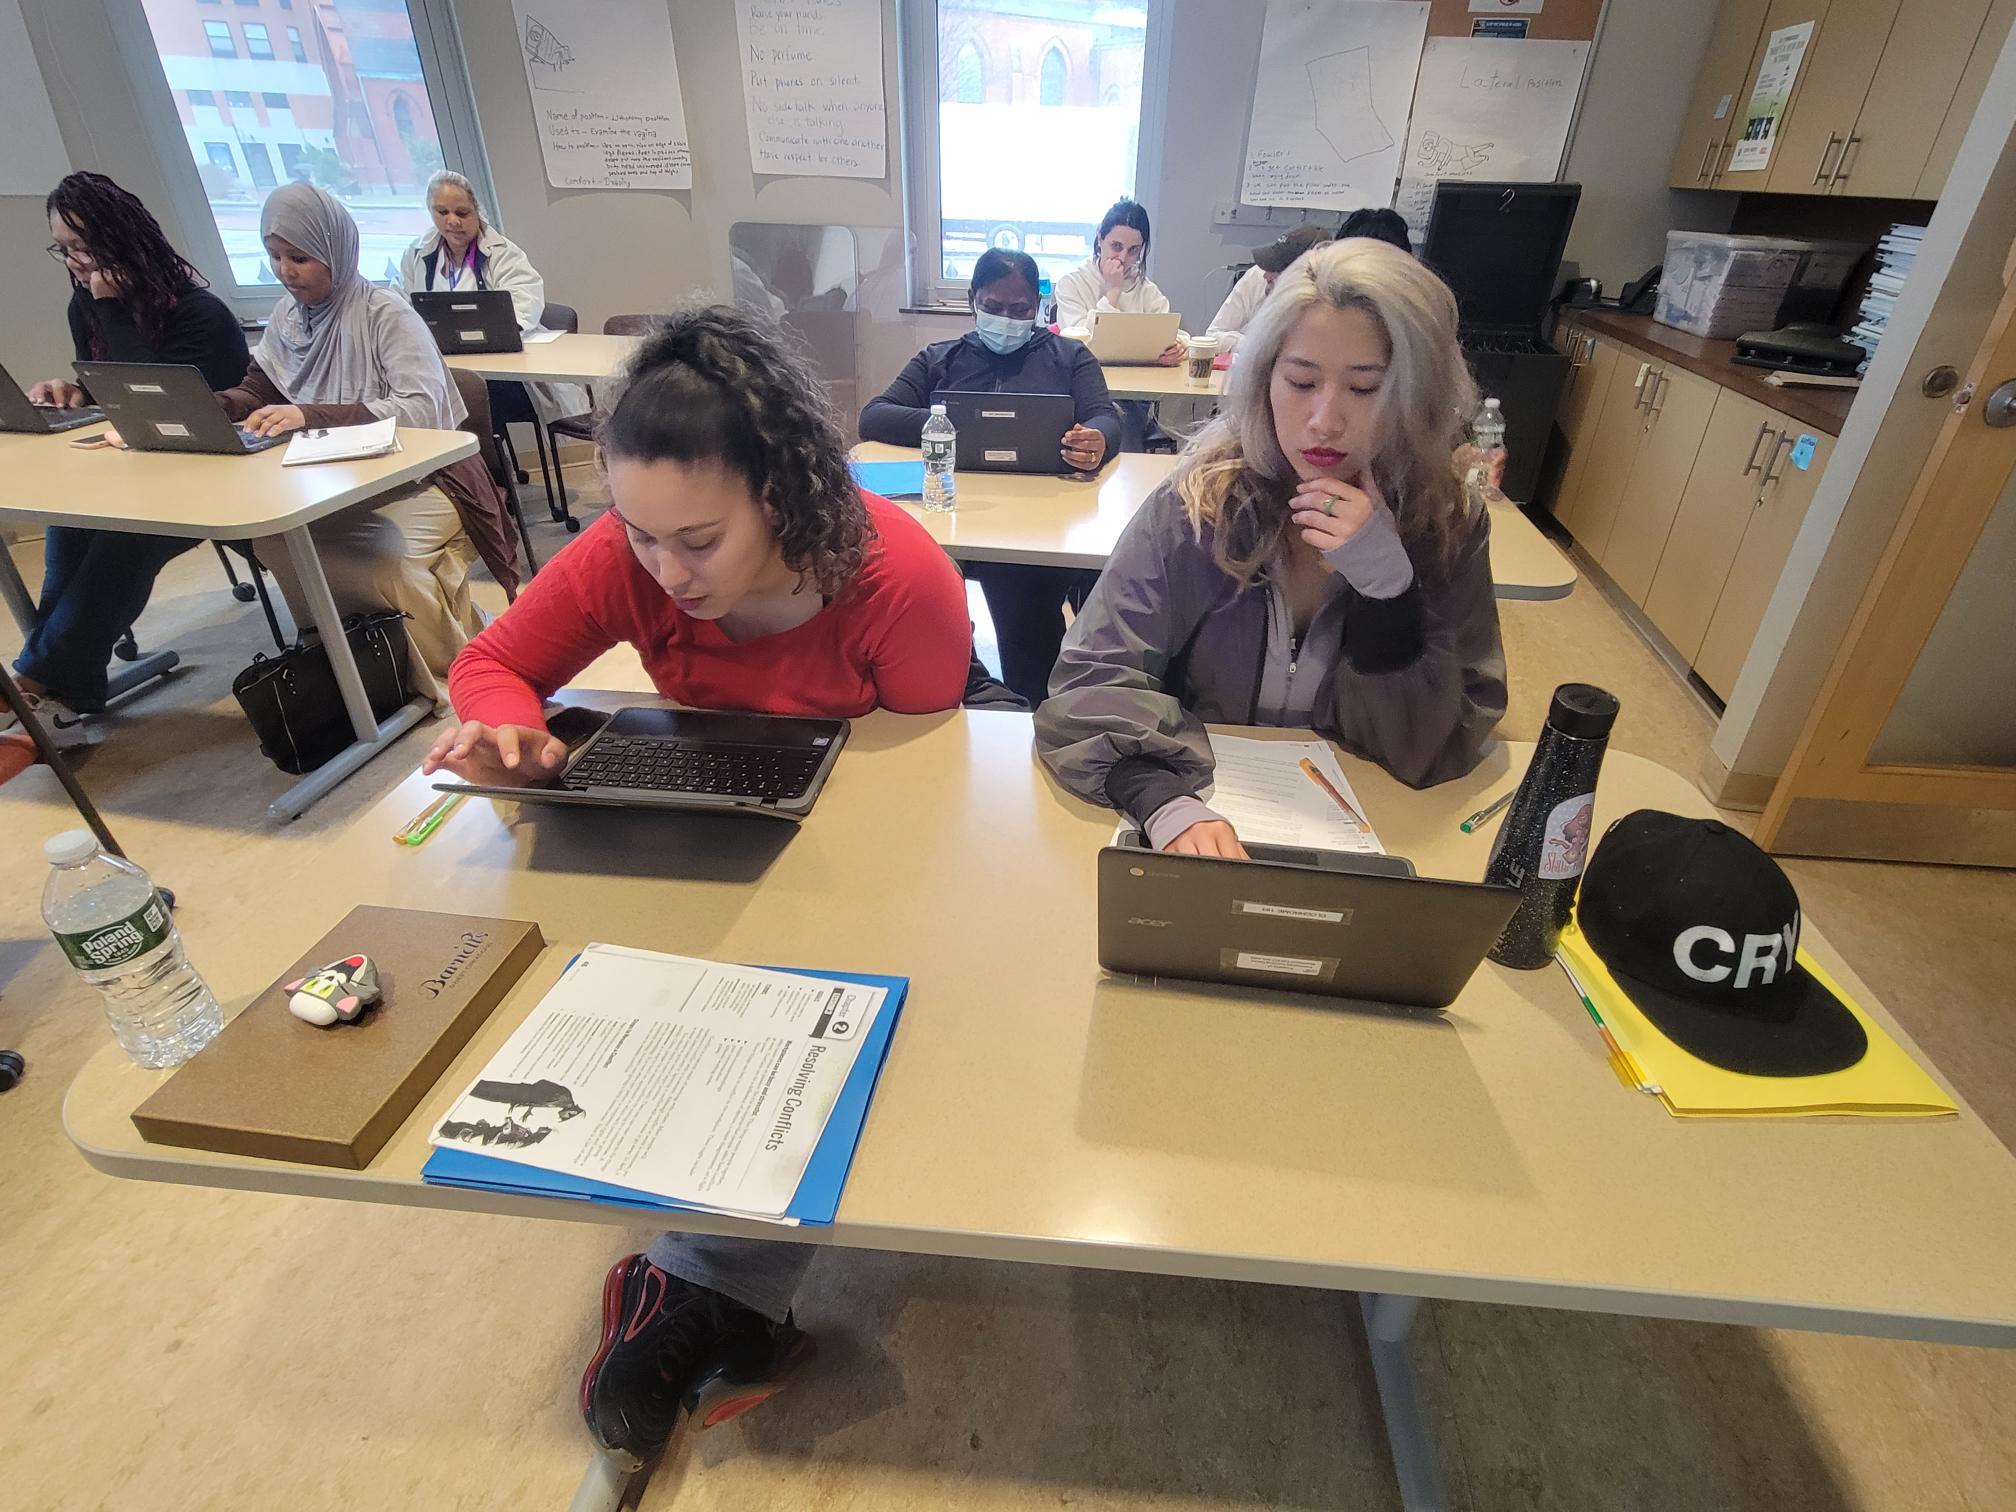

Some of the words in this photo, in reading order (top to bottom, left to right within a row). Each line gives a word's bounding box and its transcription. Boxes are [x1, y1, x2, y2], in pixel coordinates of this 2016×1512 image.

[750, 44, 764, 62] No
[750, 70, 767, 86] Put
[830, 74, 858, 87] silent
[1459, 63, 1520, 89] Lateral
[752, 97, 768, 112] No
[822, 99, 848, 111] when
[547, 109, 568, 120] Name
[571, 108, 578, 120] of
[759, 149, 779, 160] Have
[1128, 916, 1173, 928] acer
[81, 920, 136, 954] Poland
[90, 930, 144, 965] Spring
[786, 1044, 827, 1096] Resolving
[765, 1099, 803, 1152] Conflicts
